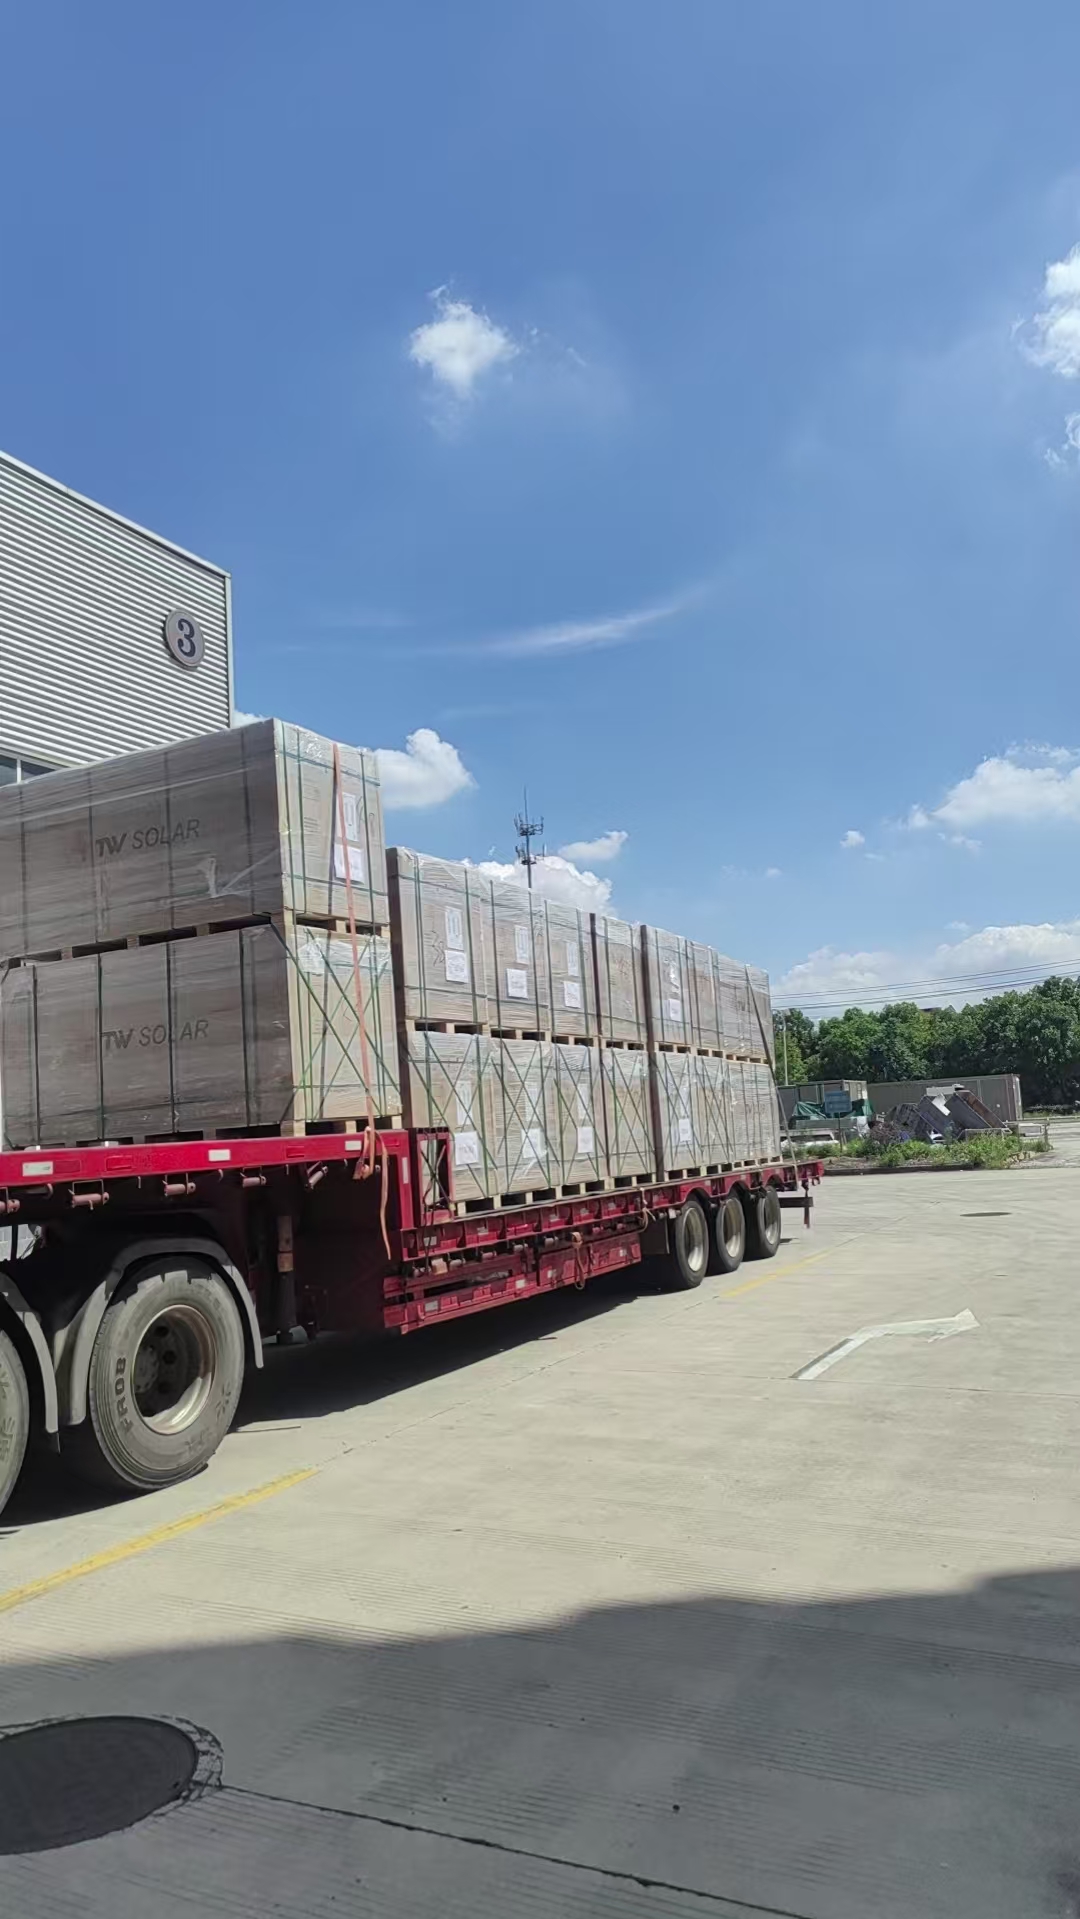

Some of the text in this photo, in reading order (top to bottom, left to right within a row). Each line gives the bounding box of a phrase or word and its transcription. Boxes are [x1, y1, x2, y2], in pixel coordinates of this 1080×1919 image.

[177, 618, 196, 658] 3
[95, 818, 200, 858] TW SOLAR
[100, 1019, 209, 1050] TW SOAR
